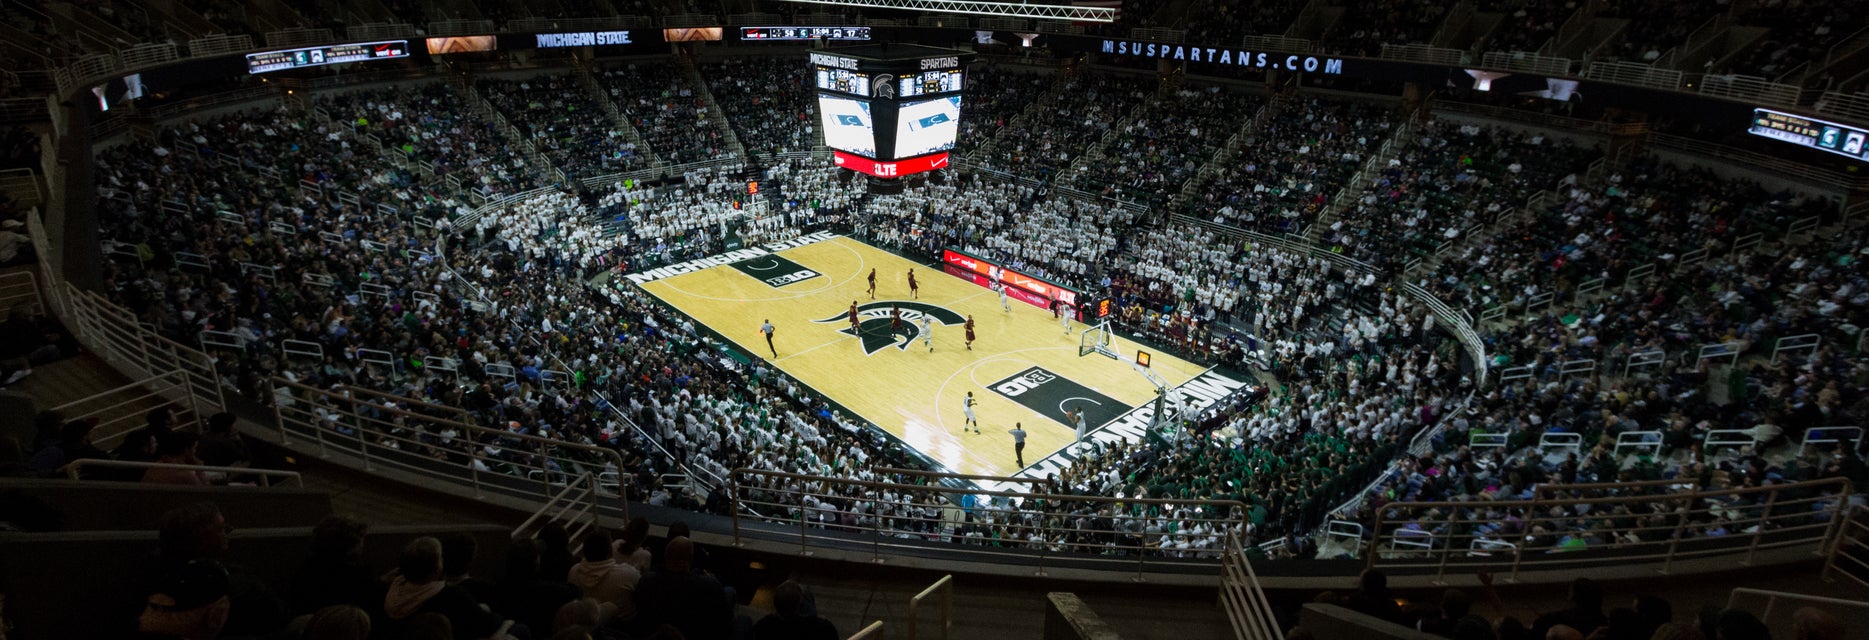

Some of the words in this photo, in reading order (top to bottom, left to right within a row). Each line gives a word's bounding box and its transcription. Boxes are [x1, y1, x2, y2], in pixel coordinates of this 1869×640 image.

[536, 32, 595, 48] MICHIGAN
[596, 31, 632, 45] STATE
[810, 53, 838, 67] MICHIGAN
[839, 57, 858, 70] STATE
[921, 56, 958, 70] SPARTANS
[1102, 39, 1343, 74] MSUSPARTANS.COM
[624, 246, 770, 285] MICHIGAN
[764, 230, 842, 252] STATE
